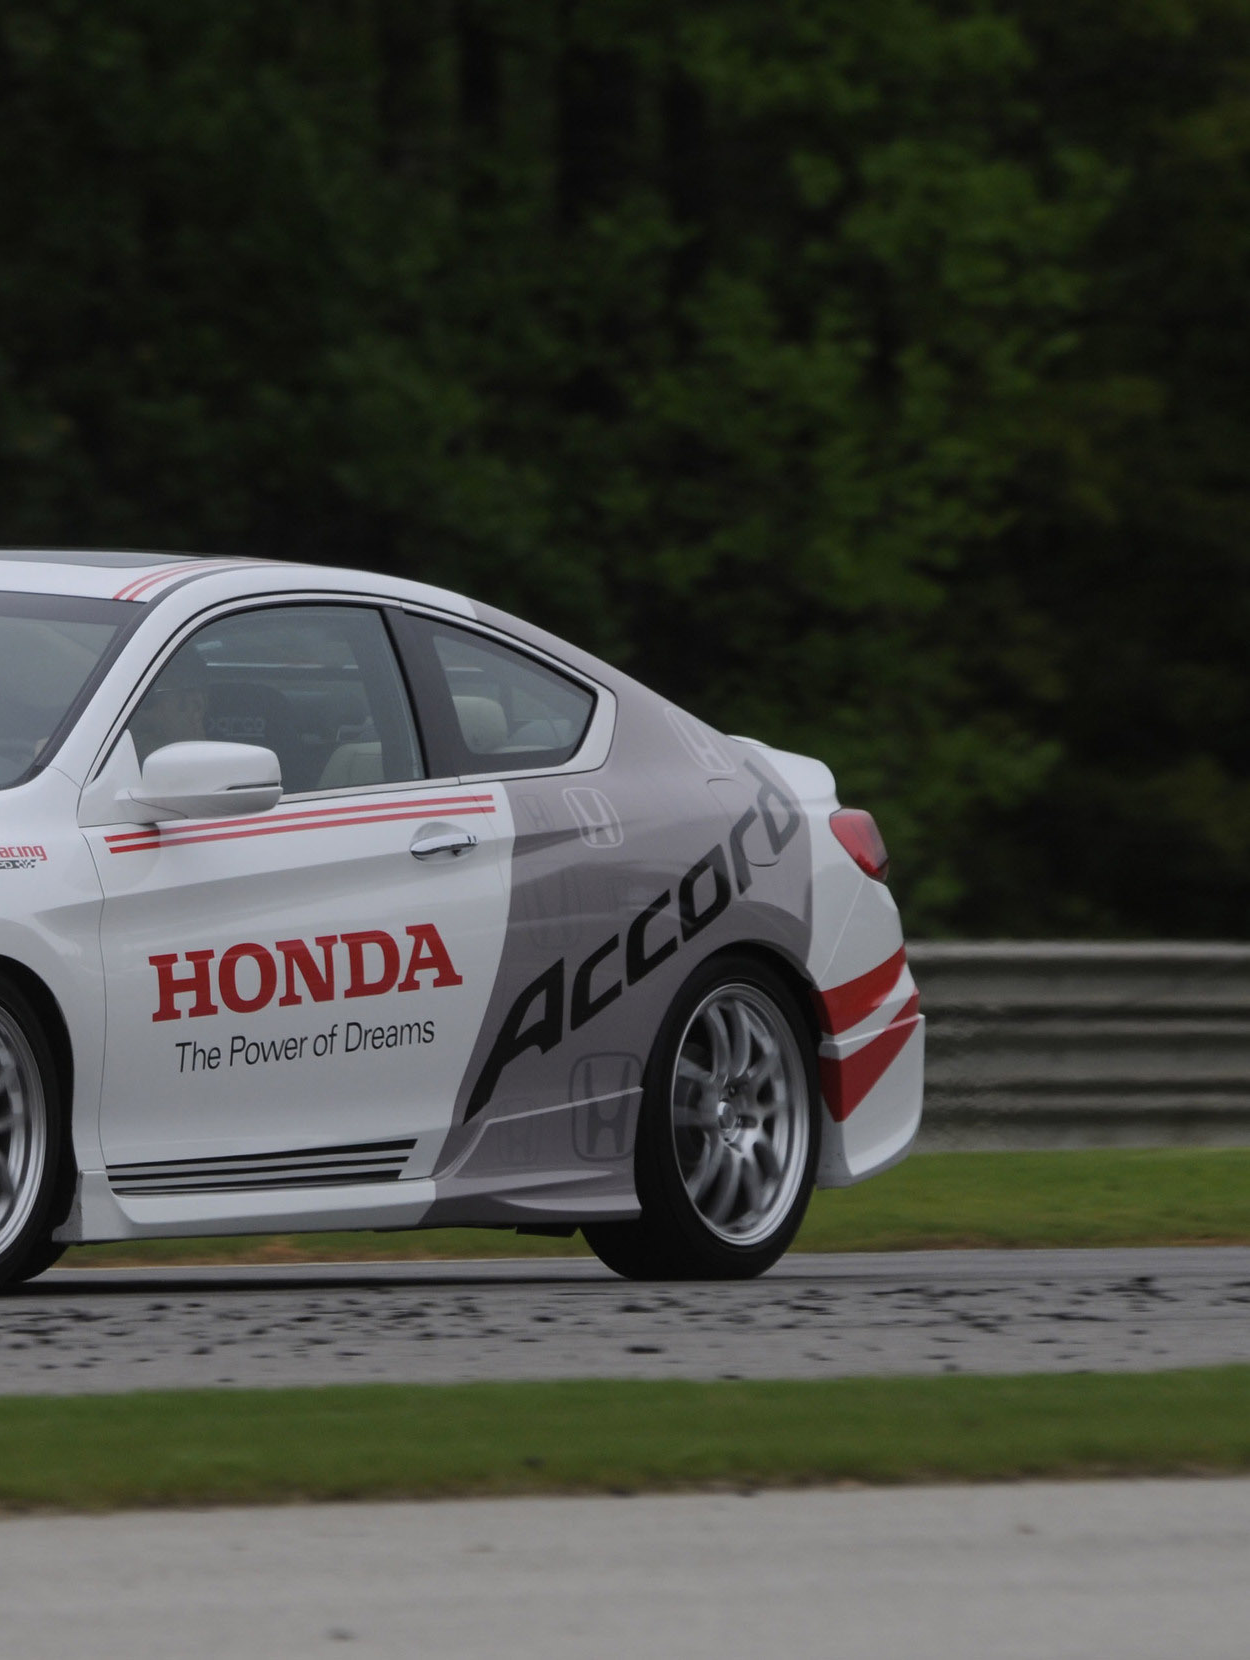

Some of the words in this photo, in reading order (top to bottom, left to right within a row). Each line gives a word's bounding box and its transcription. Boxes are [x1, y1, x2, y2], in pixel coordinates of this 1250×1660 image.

[148, 923, 463, 1022] HONDA
[462, 760, 801, 1126] Accord
[175, 1041, 221, 1073] The
[229, 1035, 308, 1067] Power
[312, 1024, 339, 1057] of
[344, 1020, 436, 1053] Dreams
